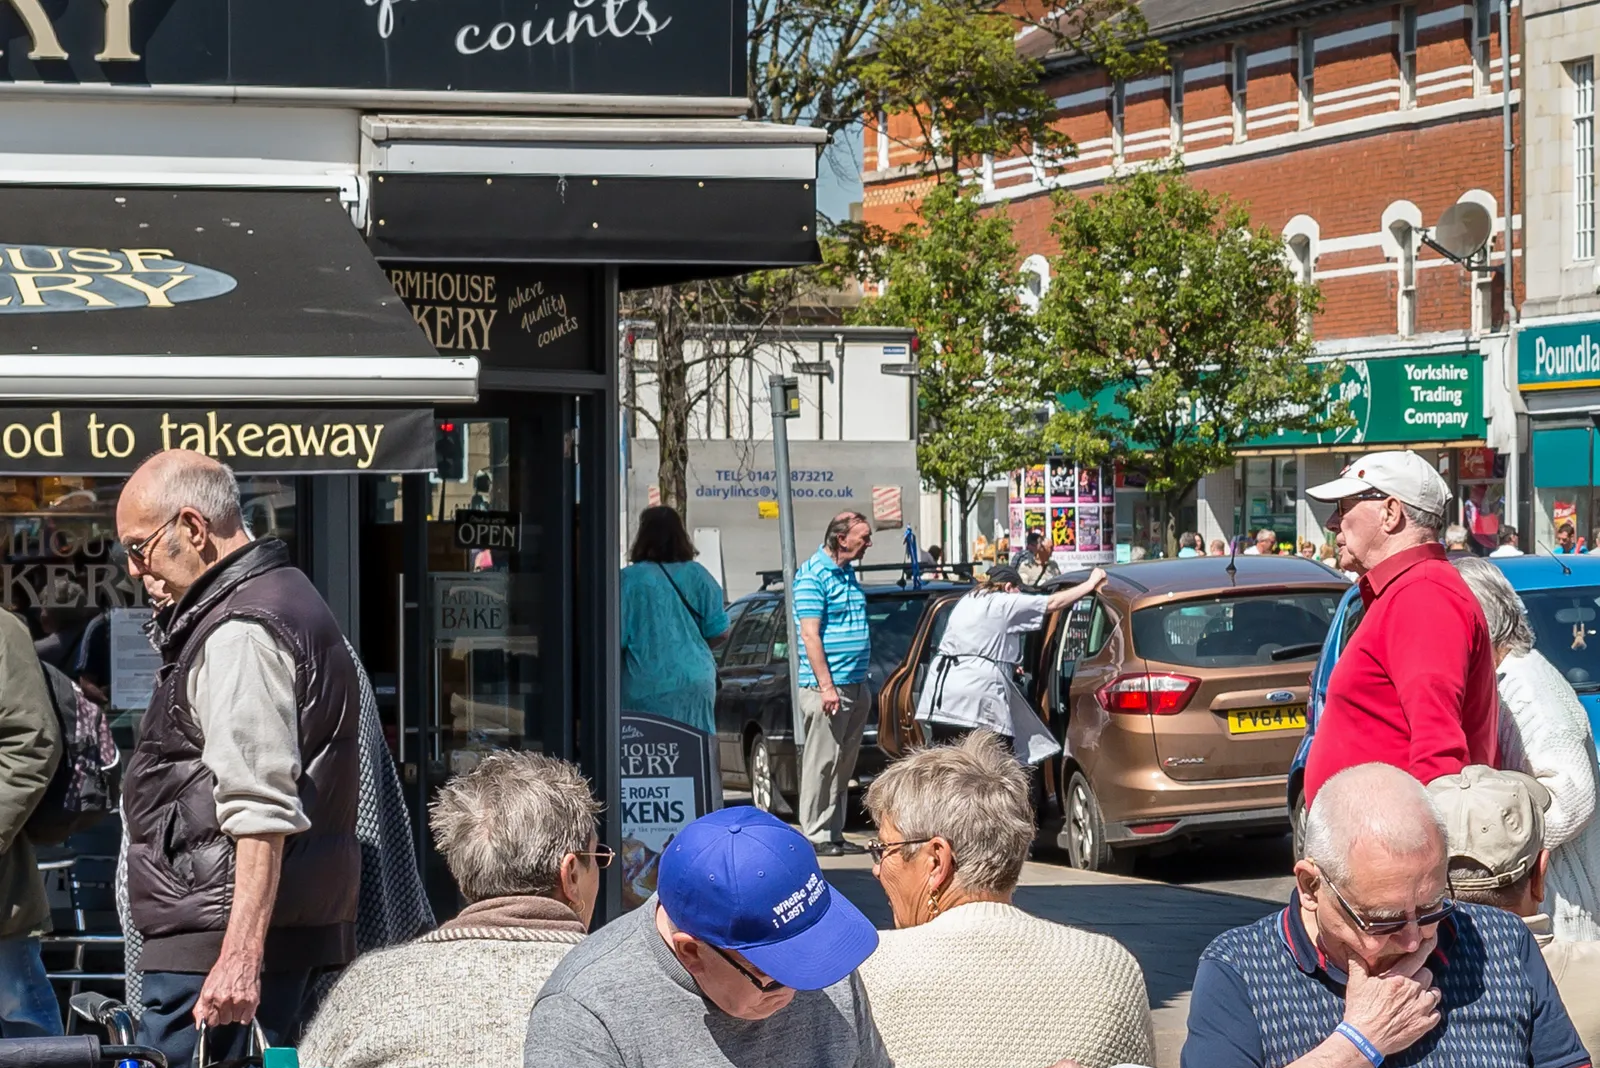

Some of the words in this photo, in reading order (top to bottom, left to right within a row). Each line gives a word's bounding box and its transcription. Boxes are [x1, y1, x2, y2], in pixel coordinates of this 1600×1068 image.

[454, 0, 673, 55] counts
[384, 269, 498, 304] RMHOUSE
[507, 280, 545, 315] where
[520, 293, 567, 334] quality
[537, 315, 580, 349] counts
[1404, 363, 1469, 381] Yorkshire
[1410, 385, 1463, 407] Trading
[1404, 408, 1469, 429] Company
[87, 412, 136, 459] to
[160, 410, 385, 470] takeaway
[748, 470, 777, 482] 0147
[790, 471, 834, 482] 873212
[458, 523, 516, 547] OPEN
[1237, 708, 1283, 729] FV64
[630, 786, 671, 799] ROAST
